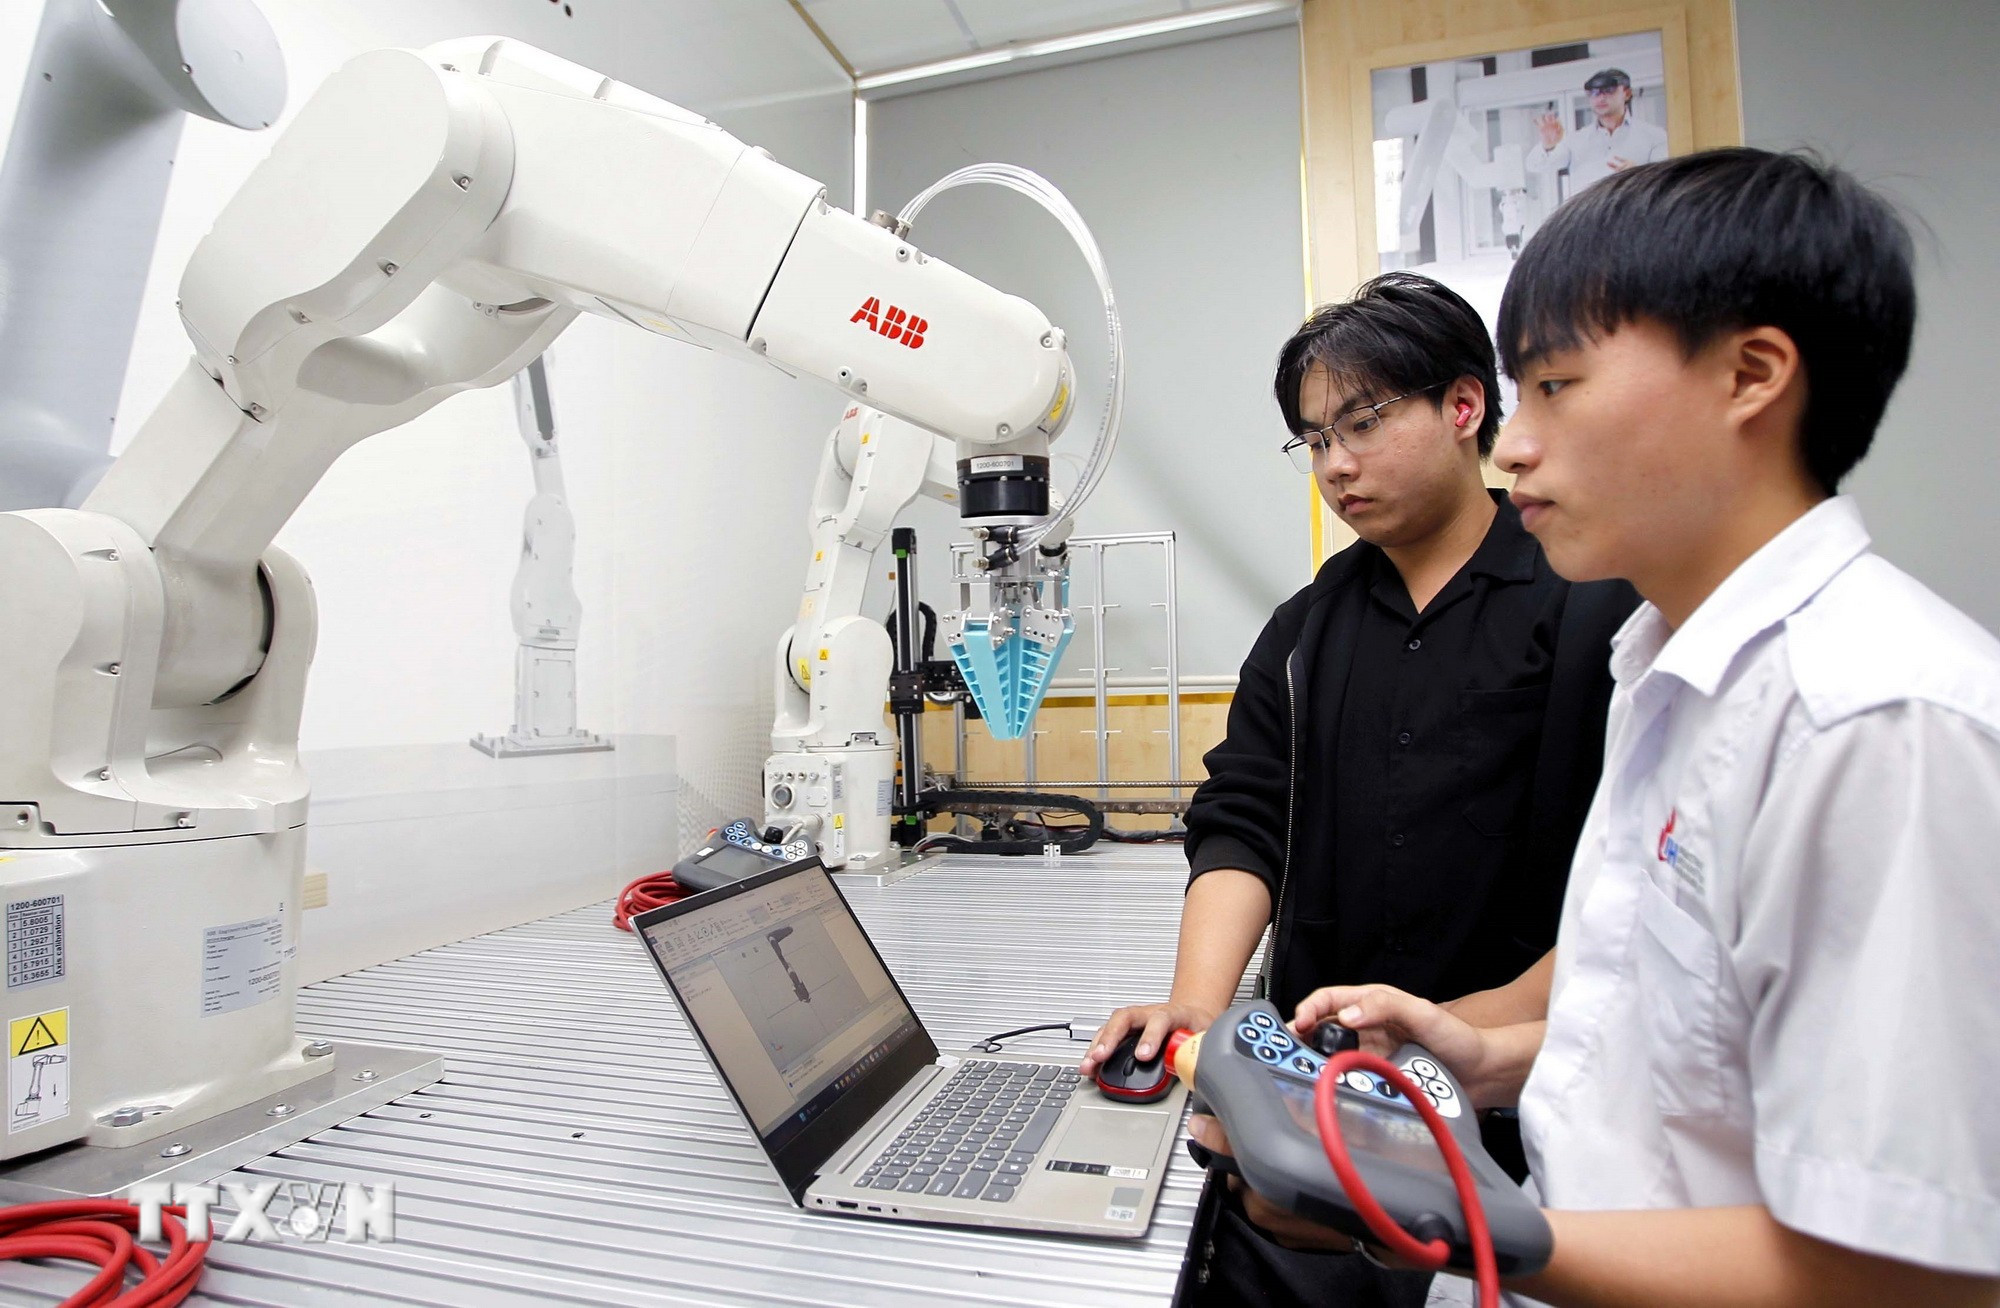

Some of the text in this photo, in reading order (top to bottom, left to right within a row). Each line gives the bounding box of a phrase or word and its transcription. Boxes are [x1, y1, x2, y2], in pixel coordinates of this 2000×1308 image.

[849, 296, 928, 350] ABB
[976, 460, 1014, 469] 1200-600701
[10, 896, 60, 911] 1200-600701
[23, 916, 48, 926] 5.8005
[23, 926, 48, 936] 1.0729
[23, 936, 48, 947] 1.2927
[23, 948, 48, 958] 1.7221
[23, 958, 49, 969] 5.7915
[23, 969, 50, 980] 5.3655
